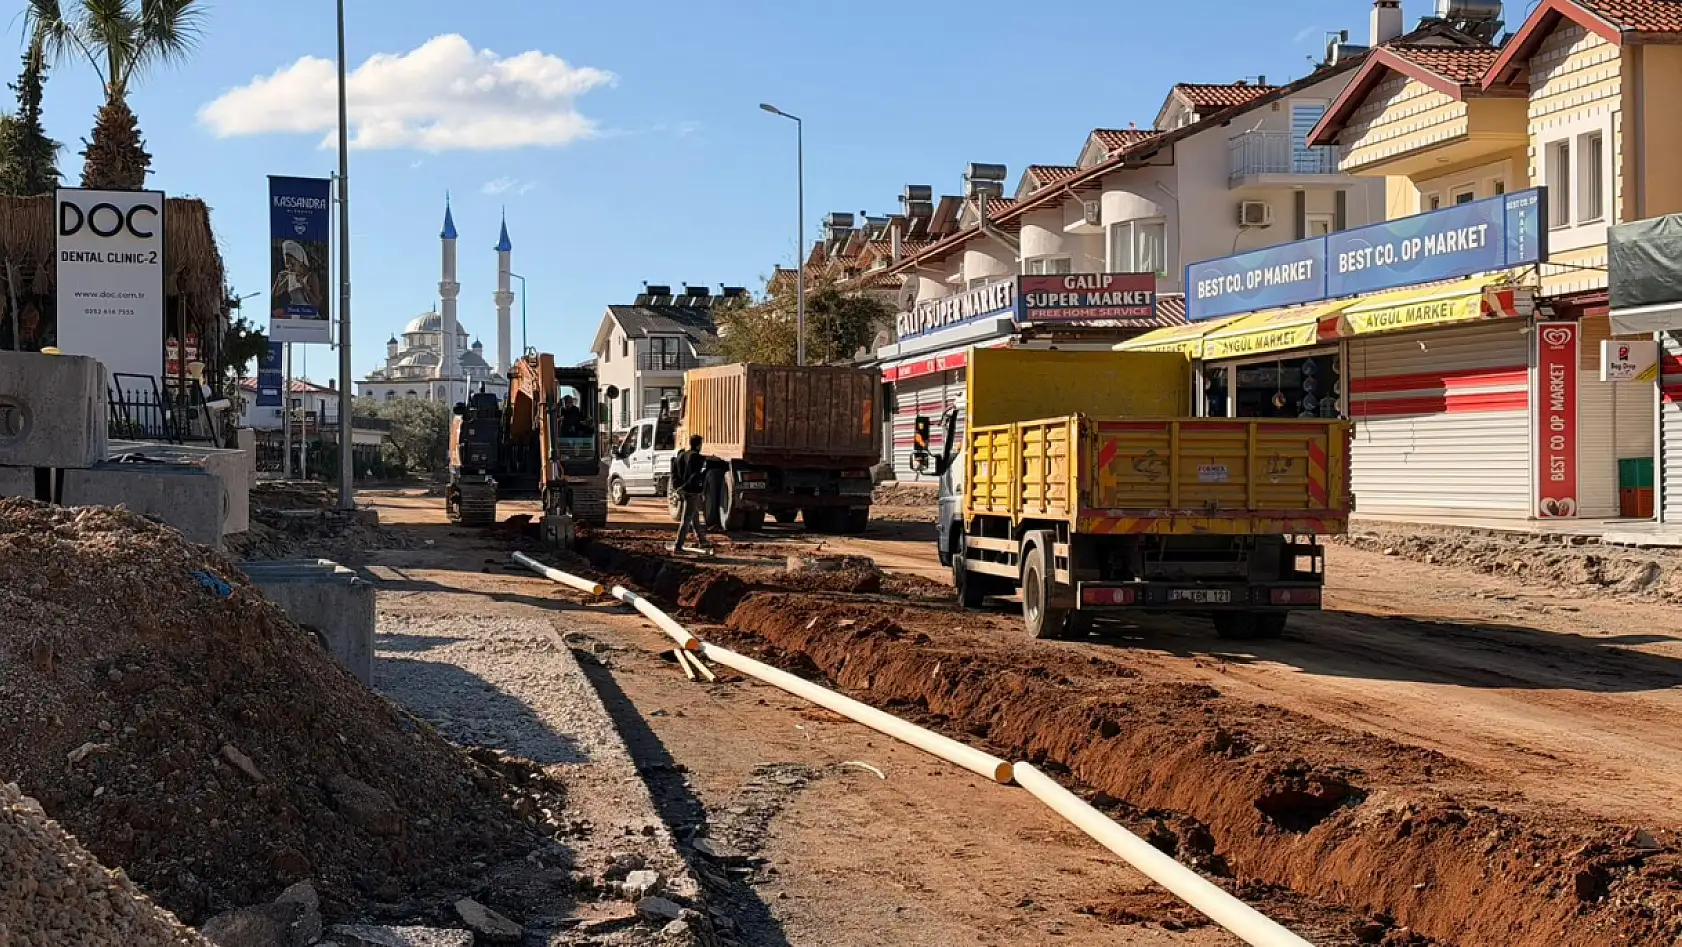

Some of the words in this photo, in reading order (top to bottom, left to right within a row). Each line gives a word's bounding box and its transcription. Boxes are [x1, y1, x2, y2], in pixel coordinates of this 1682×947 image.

[273, 195, 326, 209] KASSANDRA
[60, 201, 158, 238] DOC
[61, 251, 104, 263] DENTAL
[107, 251, 158, 265] CLINIC-2
[1339, 247, 1373, 273] BEST
[1375, 243, 1398, 266] CO.
[1401, 238, 1421, 262] OP
[1424, 224, 1488, 257] MARKET
[1198, 276, 1224, 298] BEST
[1226, 273, 1243, 293] CO.
[1246, 269, 1262, 289] OP
[1264, 259, 1312, 287] MARKET
[926, 299, 960, 329] SUPER
[962, 281, 1012, 320] MARKET
[1025, 293, 1080, 307] SUPER
[1086, 290, 1153, 306] MARKET
[1031, 309, 1061, 317] FREE
[1063, 308, 1096, 317] HOME
[1099, 307, 1147, 316] SERVICE
[1405, 302, 1456, 322] MARKET
[1255, 330, 1297, 349] MARKET
[1551, 363, 1565, 411] MARKET
[1551, 415, 1565, 432] OP
[1551, 435, 1565, 450] CO
[1551, 454, 1565, 481] BEST
